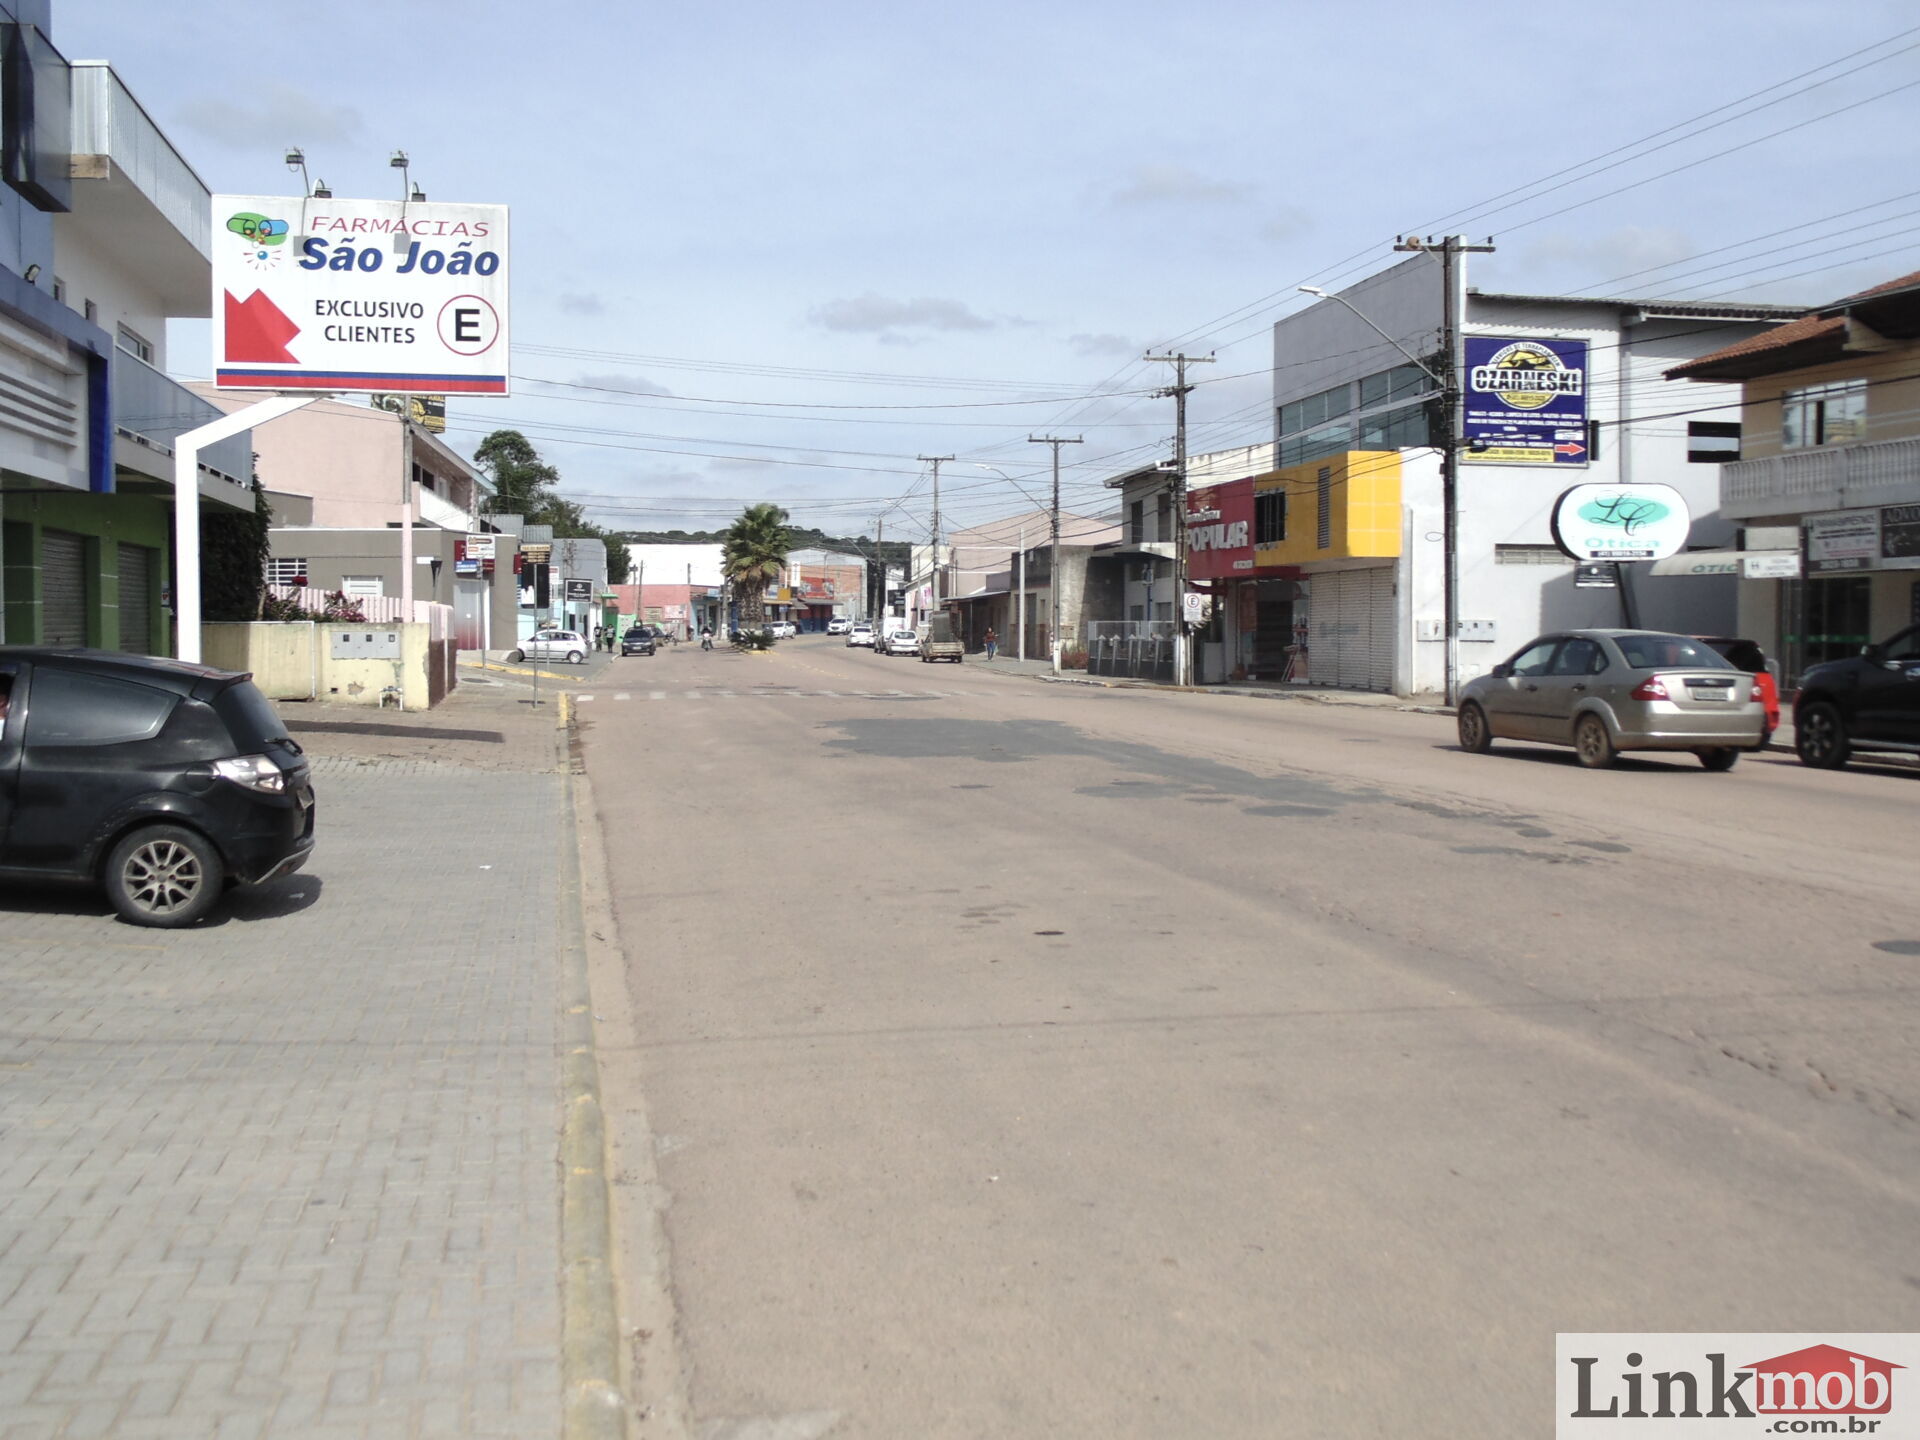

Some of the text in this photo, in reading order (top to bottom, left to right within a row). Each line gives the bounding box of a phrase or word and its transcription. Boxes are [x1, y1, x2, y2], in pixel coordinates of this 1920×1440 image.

[311, 216, 490, 237] FARMÁCIAS
[298, 237, 500, 276] São João
[315, 299, 482, 343] EXCLUSIVO E
[324, 325, 416, 344] CLIENTES
[1476, 370, 1577, 392] CZARNESKI
[1187, 520, 1249, 552] POPULAR
